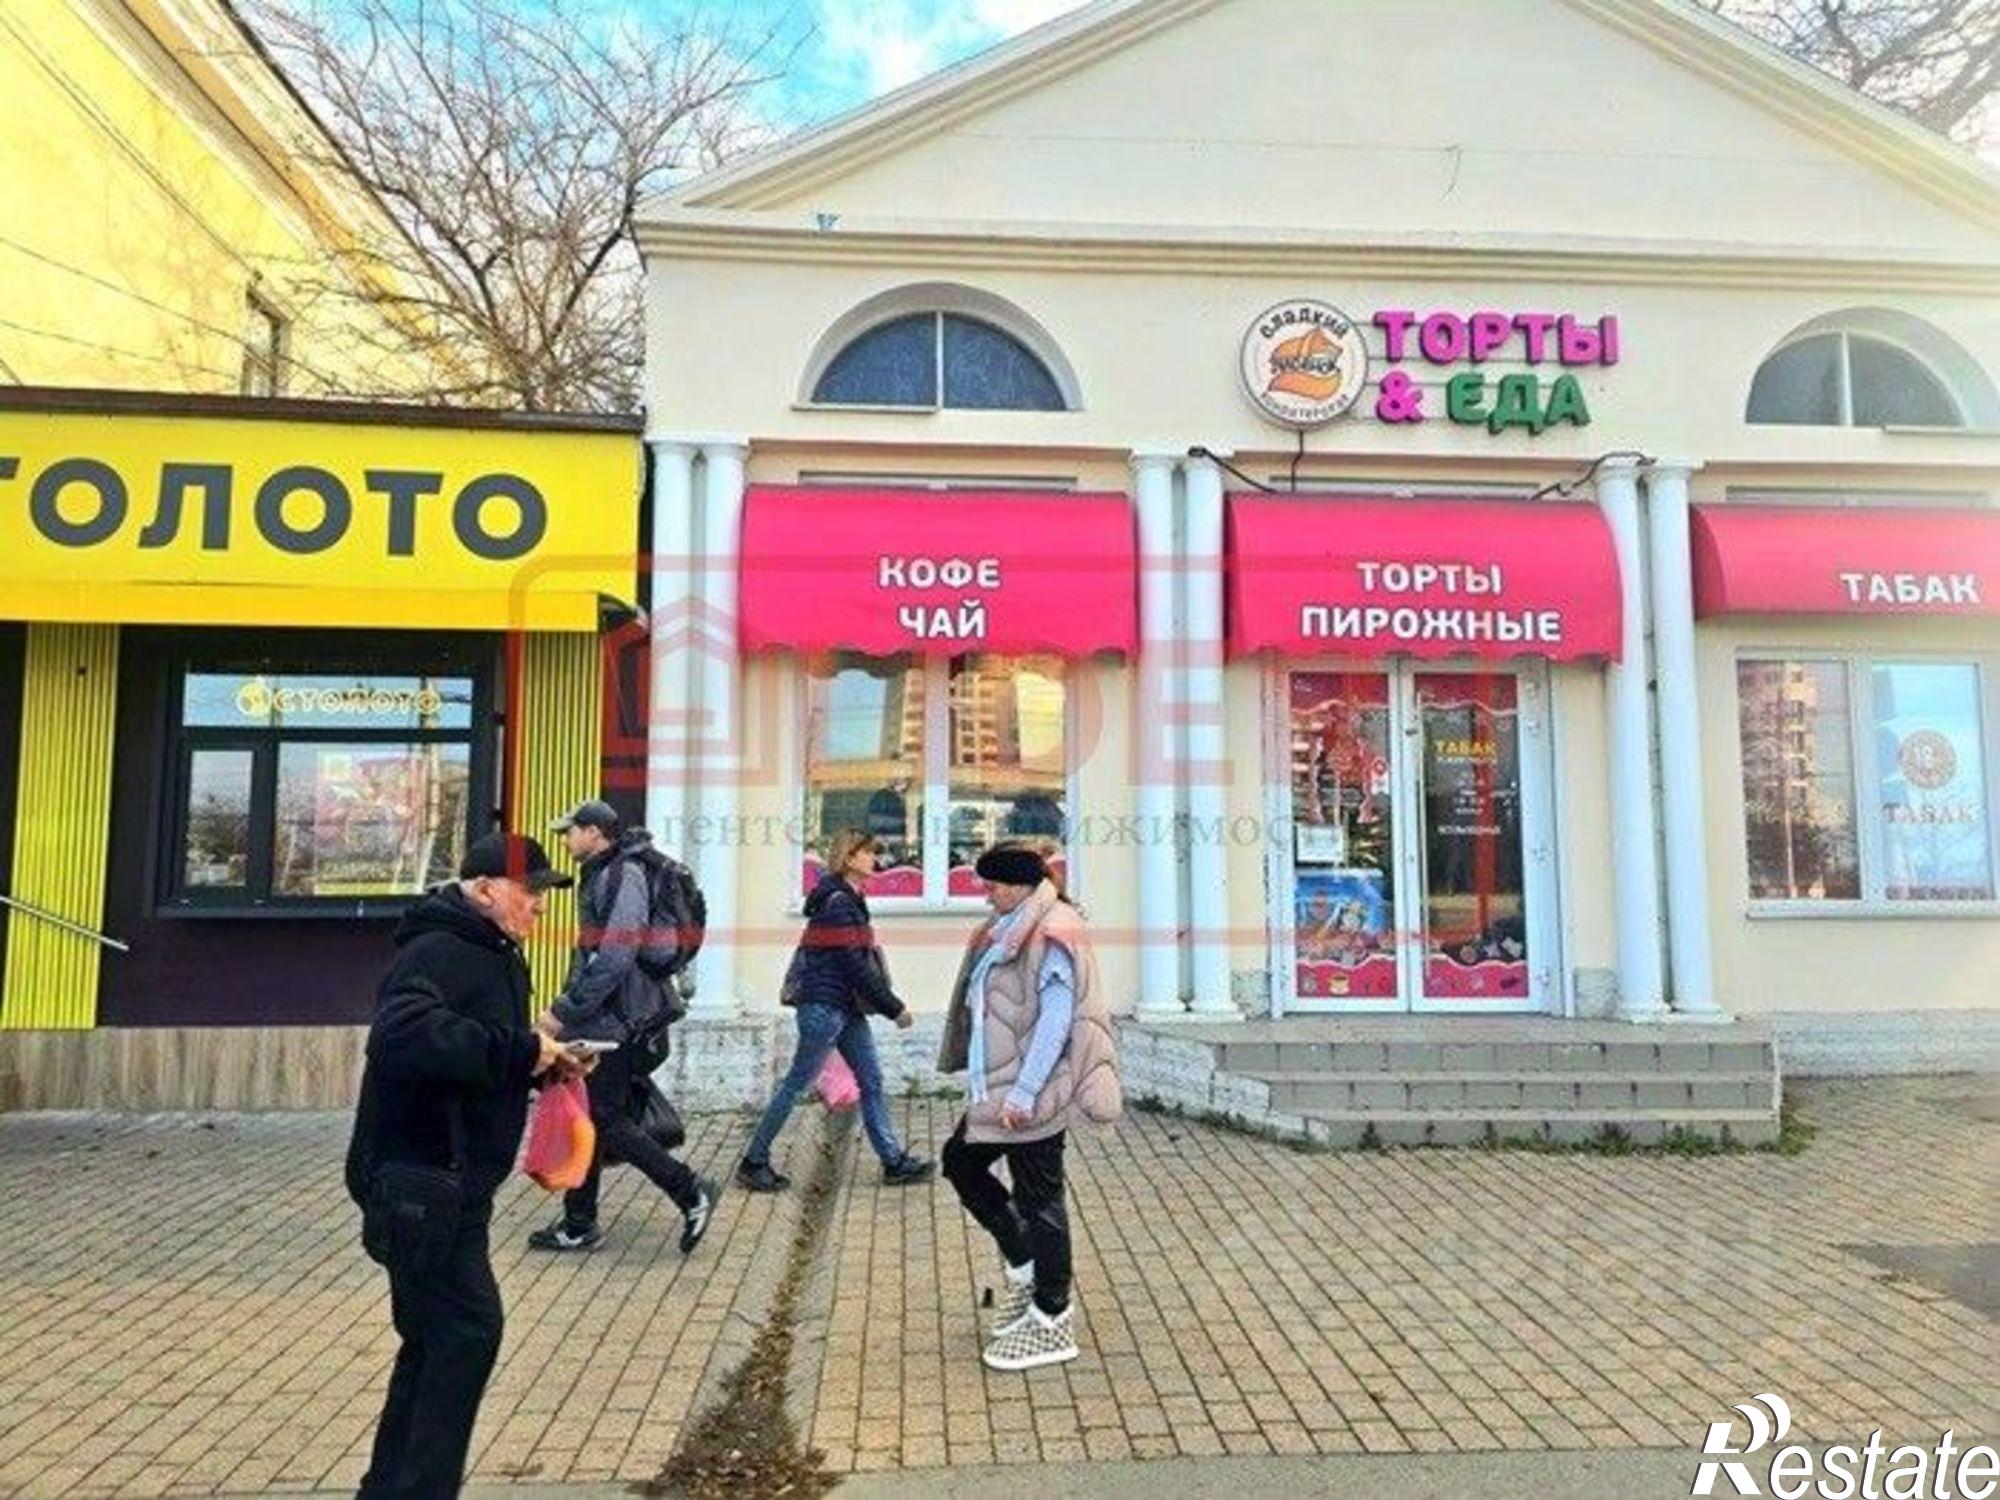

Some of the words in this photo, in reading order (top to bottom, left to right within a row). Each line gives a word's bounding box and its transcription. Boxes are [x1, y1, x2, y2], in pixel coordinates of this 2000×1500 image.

[1374, 311, 1619, 366] ТОРТЫ
[1375, 371, 1423, 424] &
[1446, 373, 1591, 435] ЕДА
[879, 557, 1000, 588] КОФЕ
[1356, 562, 1502, 595] ТОРТЫ
[1840, 573, 1981, 604] ТАБАК
[899, 600, 986, 639] ЧАЙ
[1300, 606, 1563, 642] ПИРОЖНЫЕ
